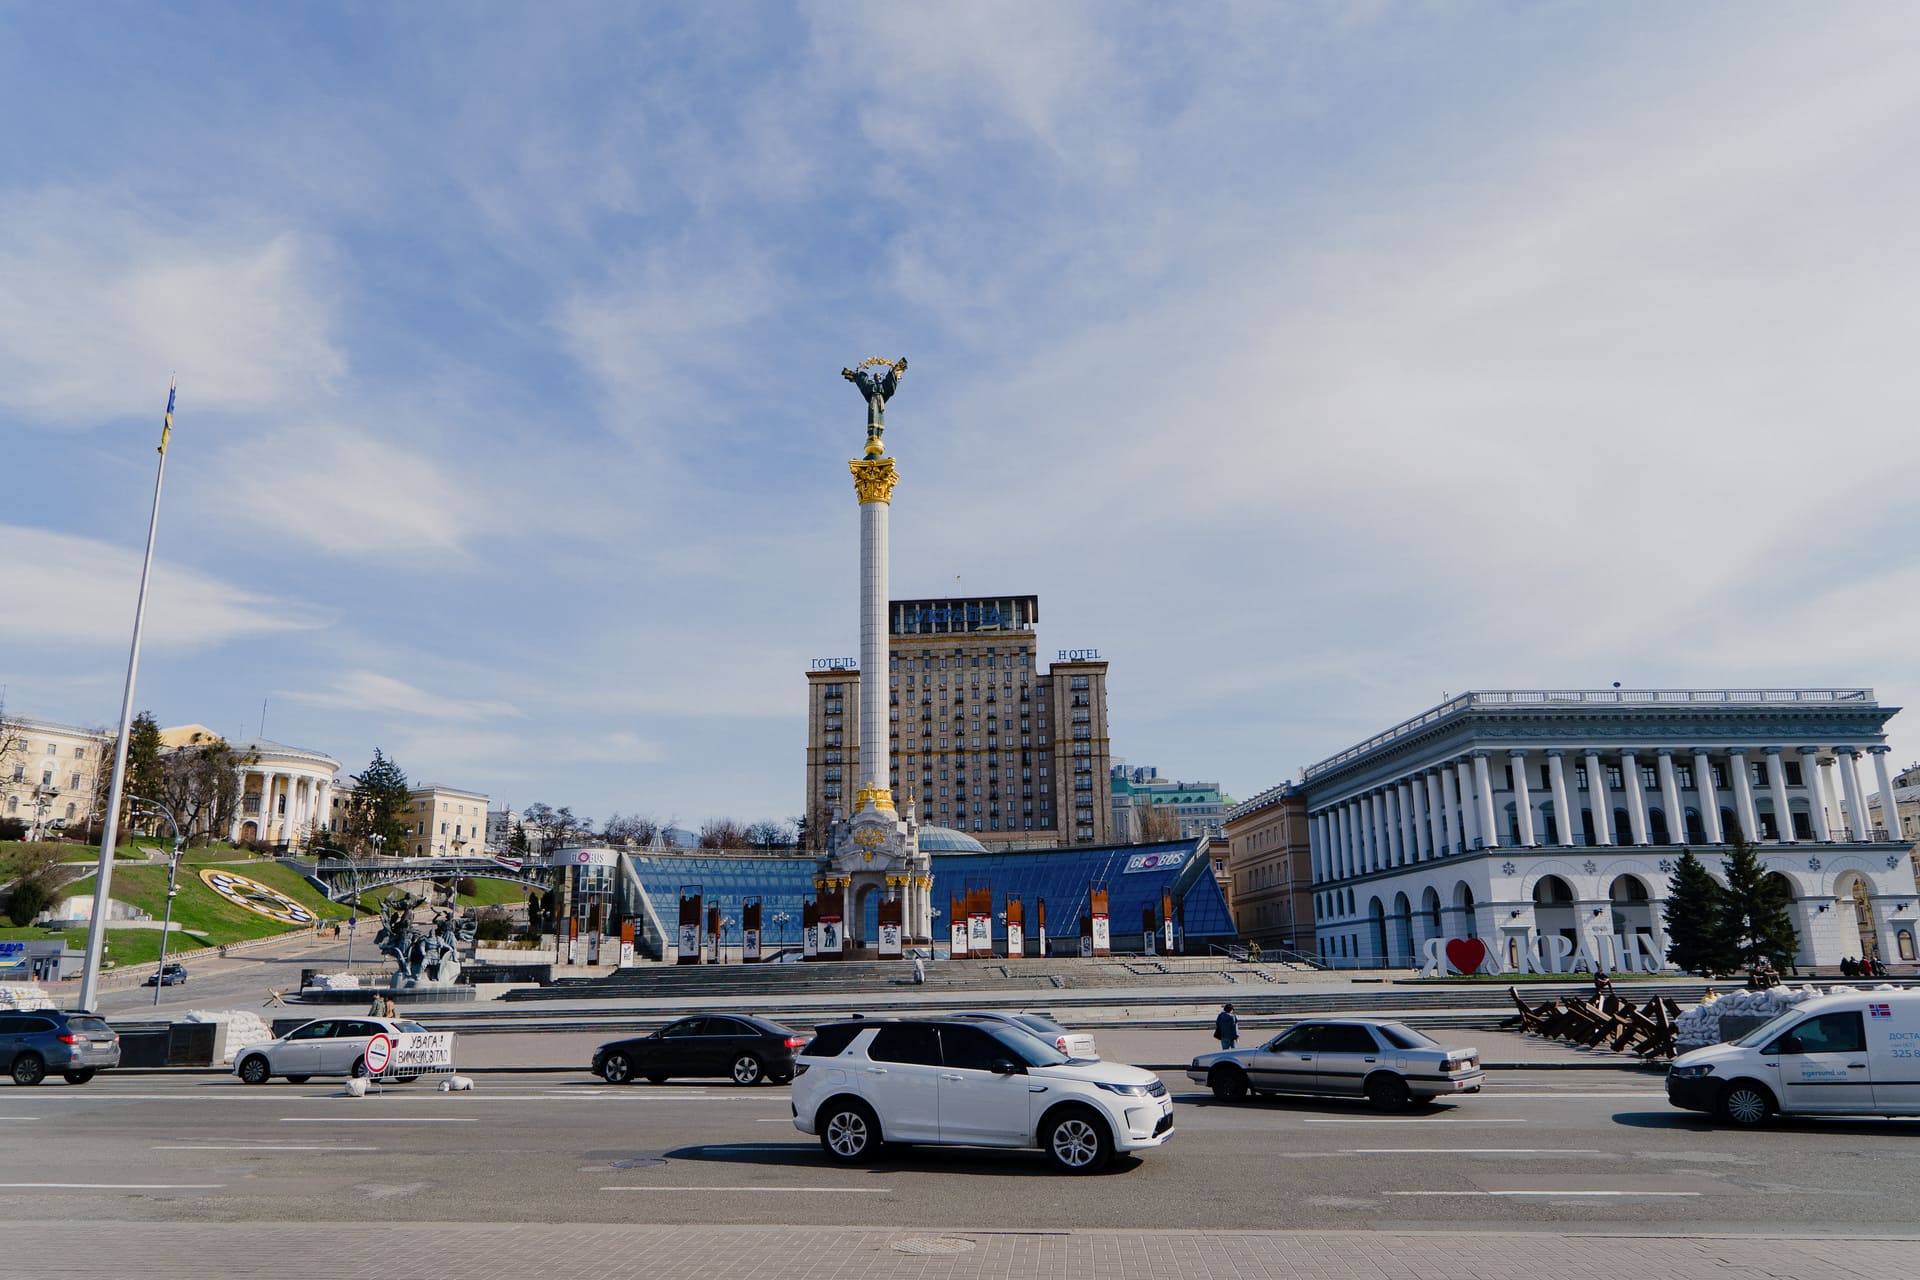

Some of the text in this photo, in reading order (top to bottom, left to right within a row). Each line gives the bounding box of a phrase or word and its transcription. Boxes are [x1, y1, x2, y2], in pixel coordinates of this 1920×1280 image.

[1058, 649, 1101, 660] HOTEL
[812, 657, 857, 669] ГОТЕЛЬ
[570, 850, 604, 863] GLOBUS
[1131, 853, 1183, 868] GLOBUS
[1420, 938, 1447, 977] Я
[1891, 1050, 1912, 1058] 325
